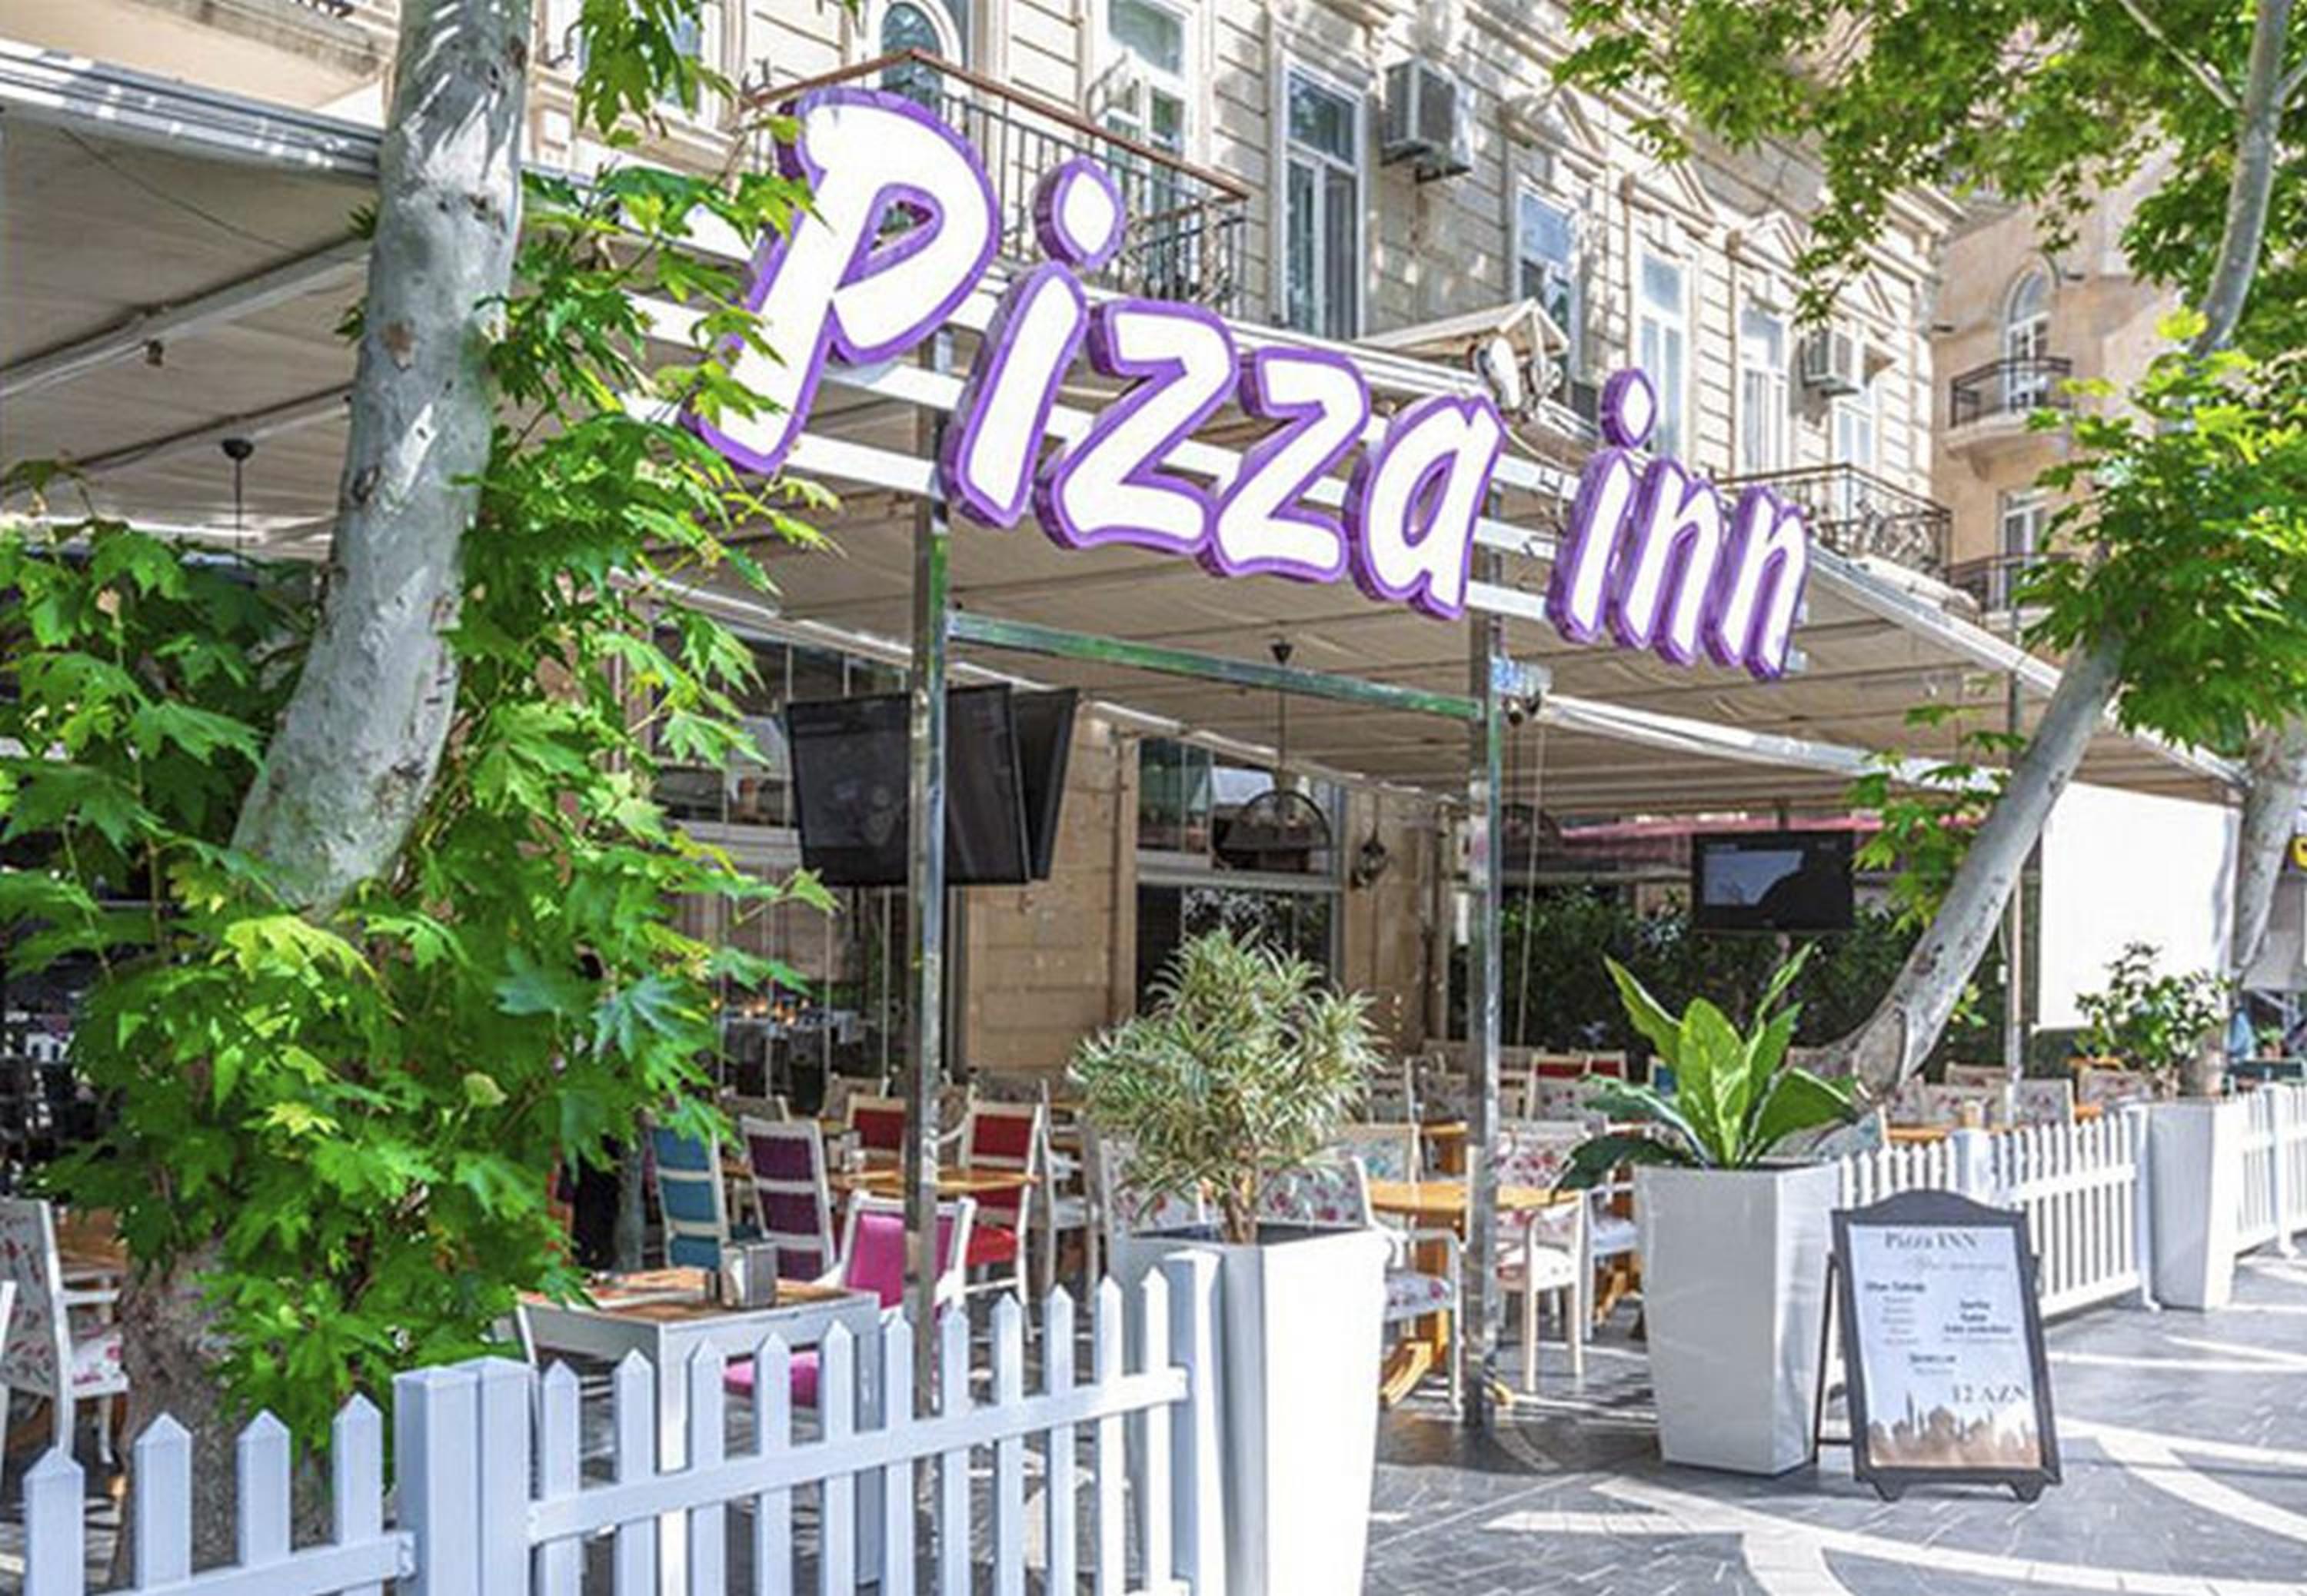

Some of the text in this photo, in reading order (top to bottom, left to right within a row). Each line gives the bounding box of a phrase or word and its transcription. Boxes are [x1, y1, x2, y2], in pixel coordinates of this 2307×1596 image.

[681, 87, 1809, 682] Pizza inn
[1952, 1385, 2028, 1403] 12 AZN
